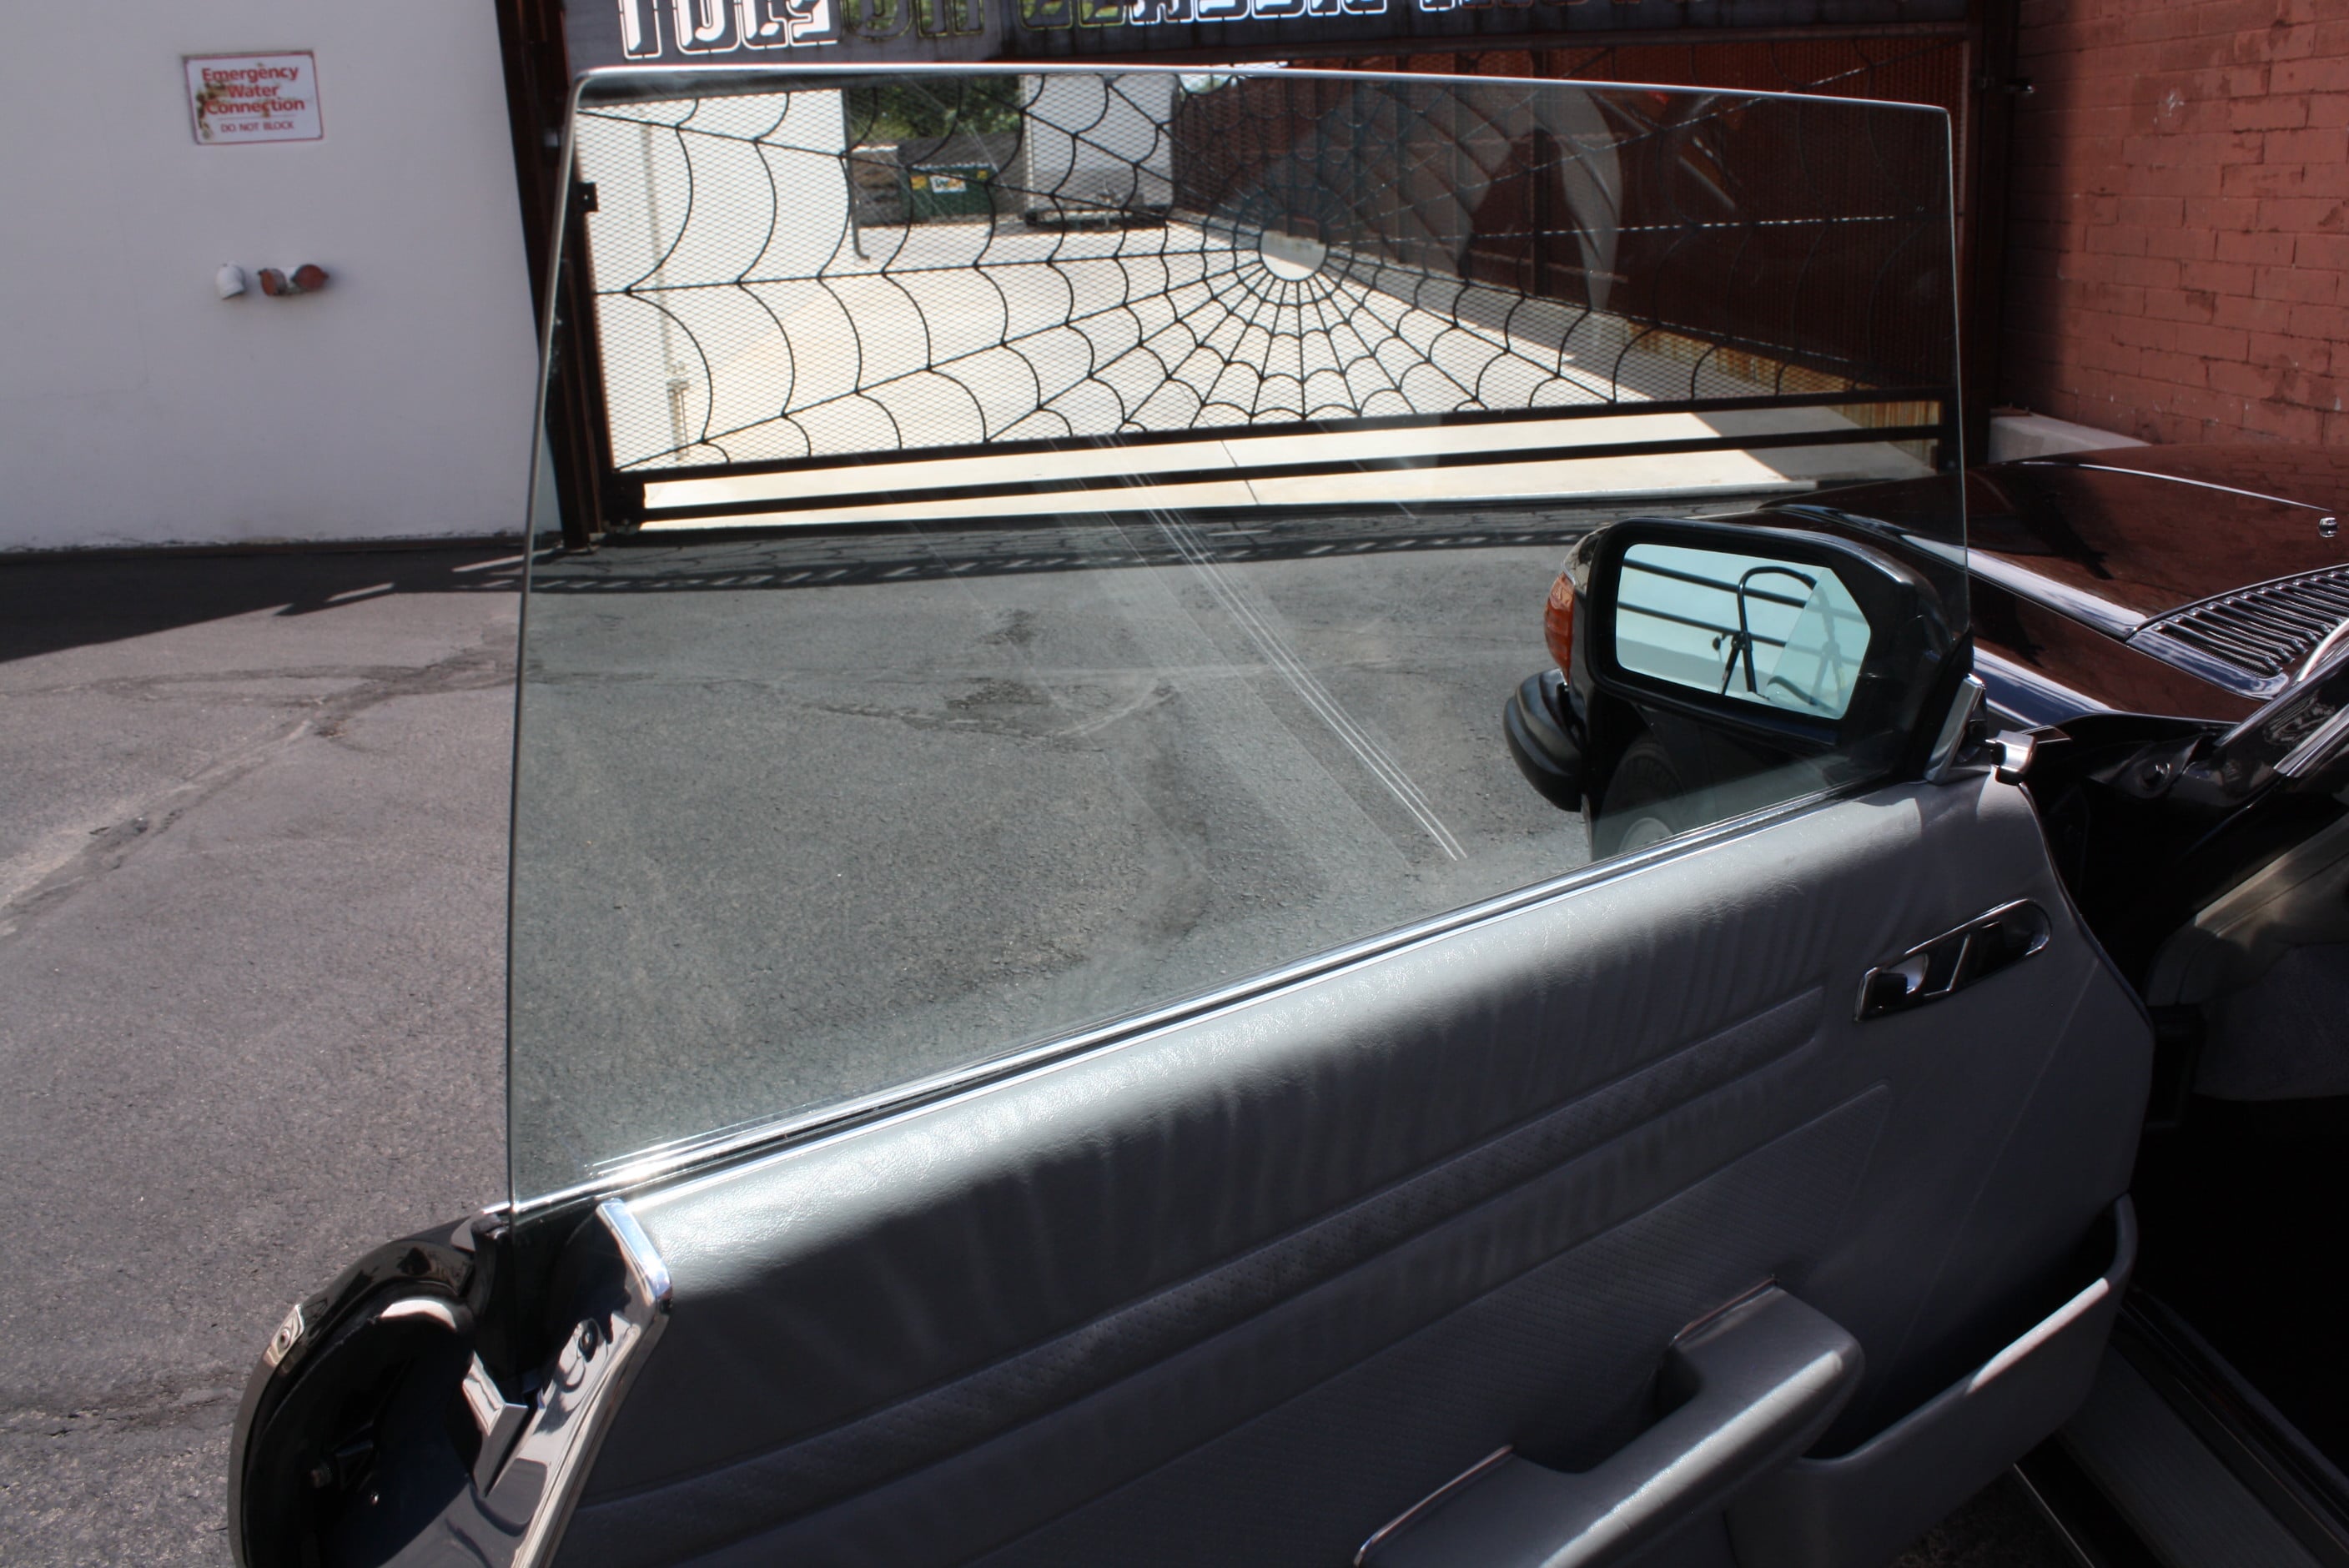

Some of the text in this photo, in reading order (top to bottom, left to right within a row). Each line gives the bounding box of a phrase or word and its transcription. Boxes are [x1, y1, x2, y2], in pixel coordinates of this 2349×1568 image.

[202, 67, 299, 83] Emergency
[227, 84, 279, 98] Water
[206, 99, 305, 115] Connection
[221, 120, 294, 133] DO NOT BLOCK
